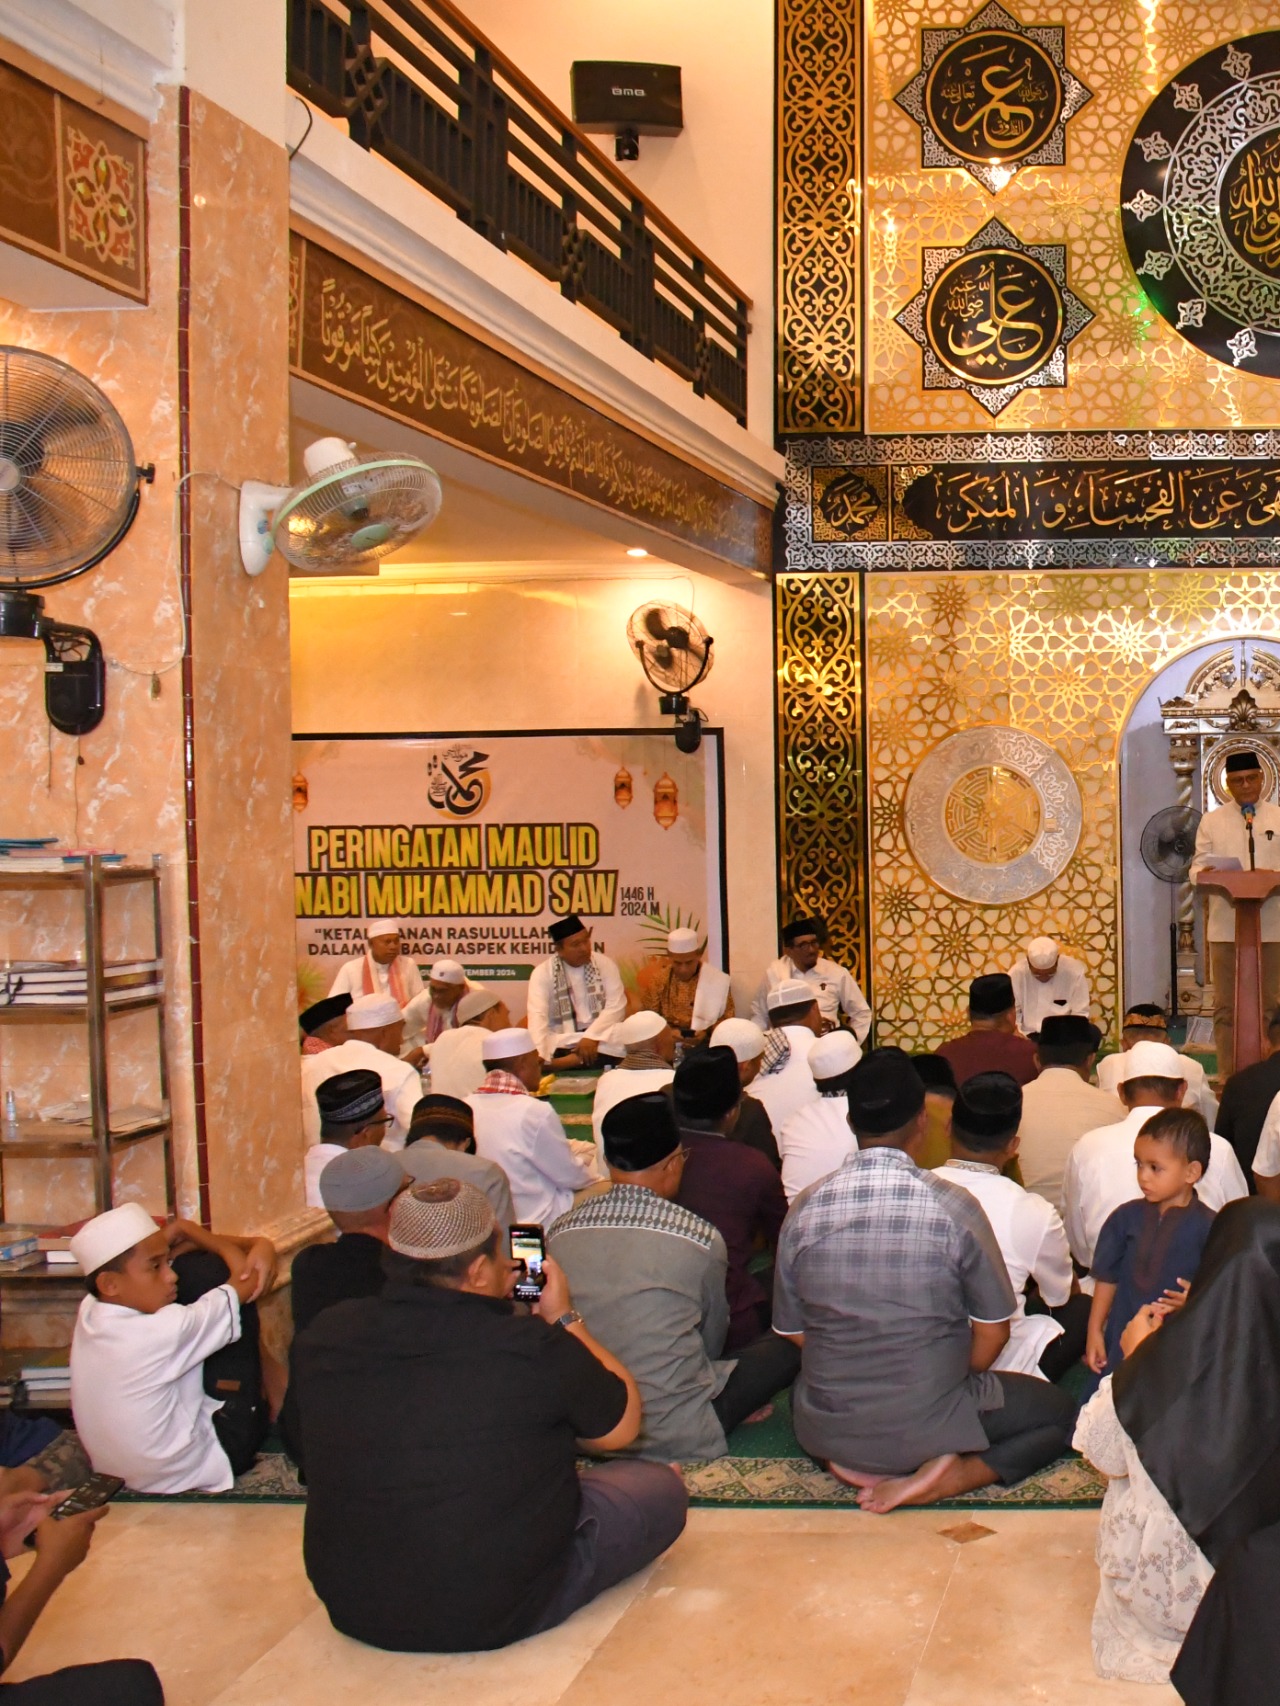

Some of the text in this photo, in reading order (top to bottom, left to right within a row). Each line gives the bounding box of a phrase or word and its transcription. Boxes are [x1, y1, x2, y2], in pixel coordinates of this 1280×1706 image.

[308, 824, 600, 870] PERINGATAN MAULID
[295, 869, 618, 917] NABI MUHAMMAD SAW
[620, 886, 655, 901] 1446 H
[620, 901, 660, 916] 2024 M
[307, 943, 366, 956] DALAM
[454, 941, 510, 955] ASPEK
